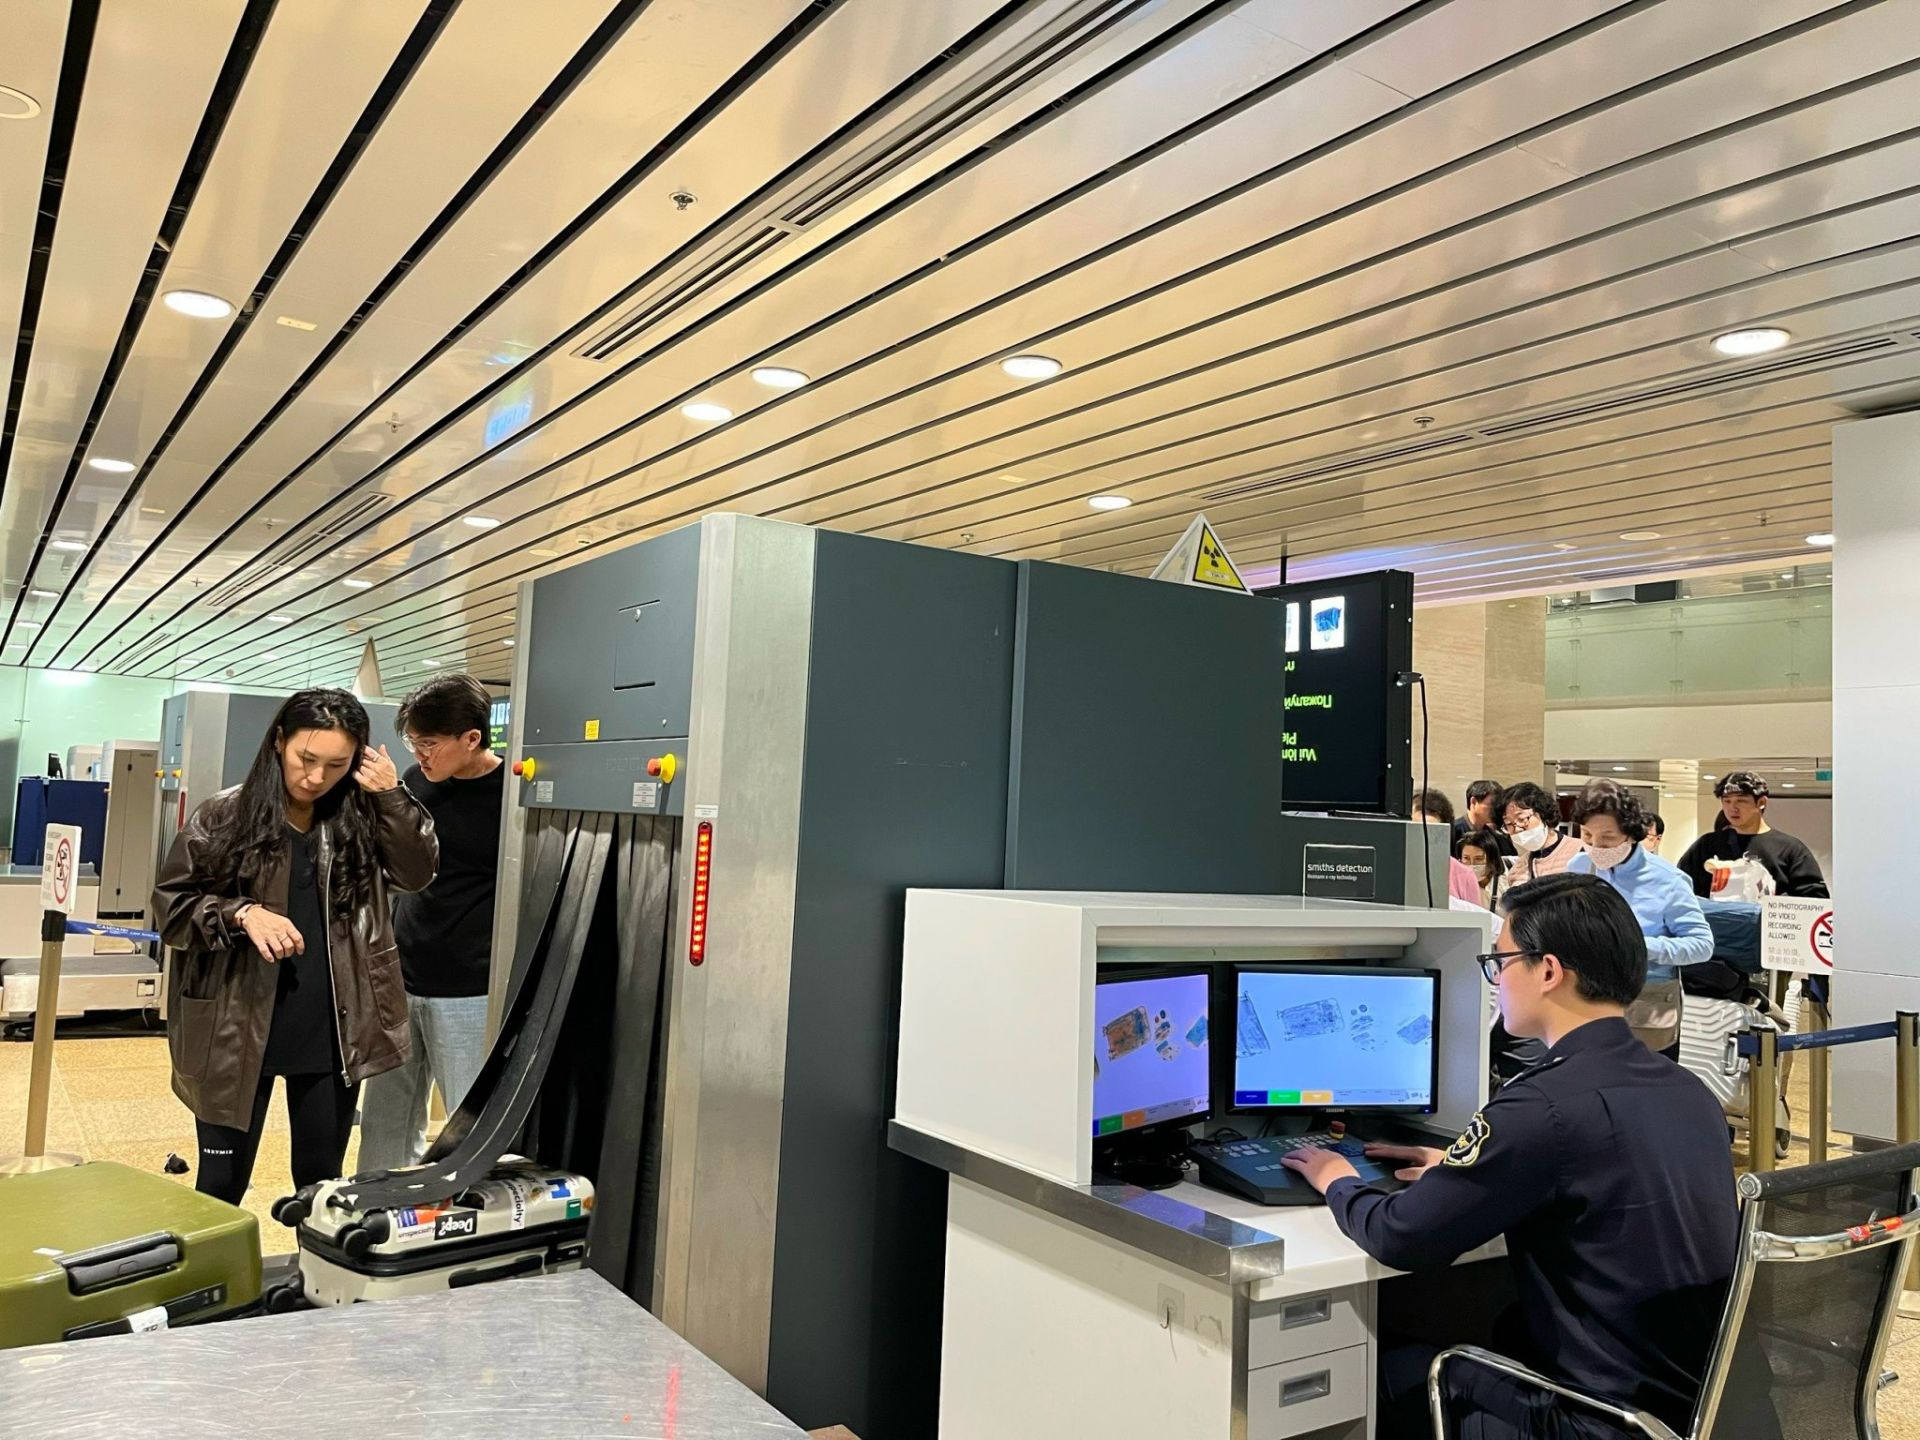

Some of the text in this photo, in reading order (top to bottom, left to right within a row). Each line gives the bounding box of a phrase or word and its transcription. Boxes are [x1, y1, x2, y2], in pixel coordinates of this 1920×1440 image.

[1299, 748, 1317, 761] Vui
[1307, 863, 1373, 873] smiths detection
[1778, 903, 1824, 912] PHOTOGRAPHY
[1779, 912, 1796, 920] VIDEO
[1768, 922, 1802, 930] RECORDING
[1768, 931, 1795, 940] ALLOWED
